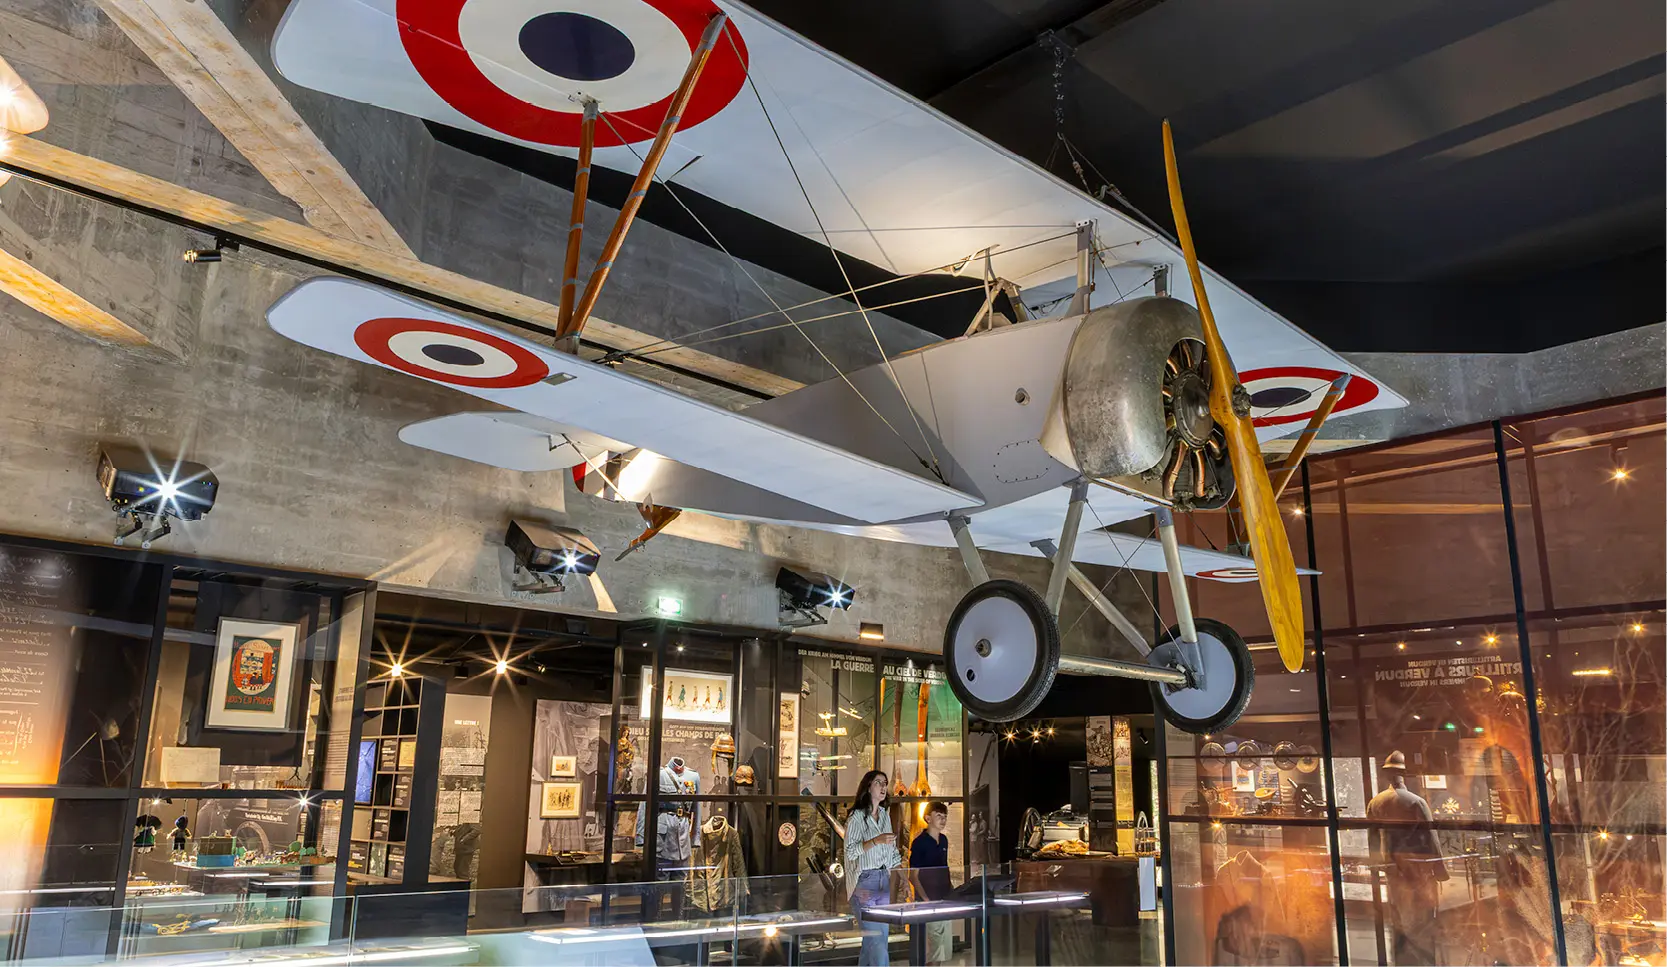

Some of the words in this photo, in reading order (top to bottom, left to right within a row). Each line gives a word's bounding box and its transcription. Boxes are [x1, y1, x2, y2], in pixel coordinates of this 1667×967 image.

[830, 659, 841, 670] LA
[843, 661, 874, 673] GUERRE
[883, 665, 895, 675] AU
[896, 667, 911, 677] CIEL
[912, 668, 922, 677] DE
[923, 670, 947, 680] VERDU
[675, 730, 703, 739] CHAMPS
[705, 731, 714, 739] DE
